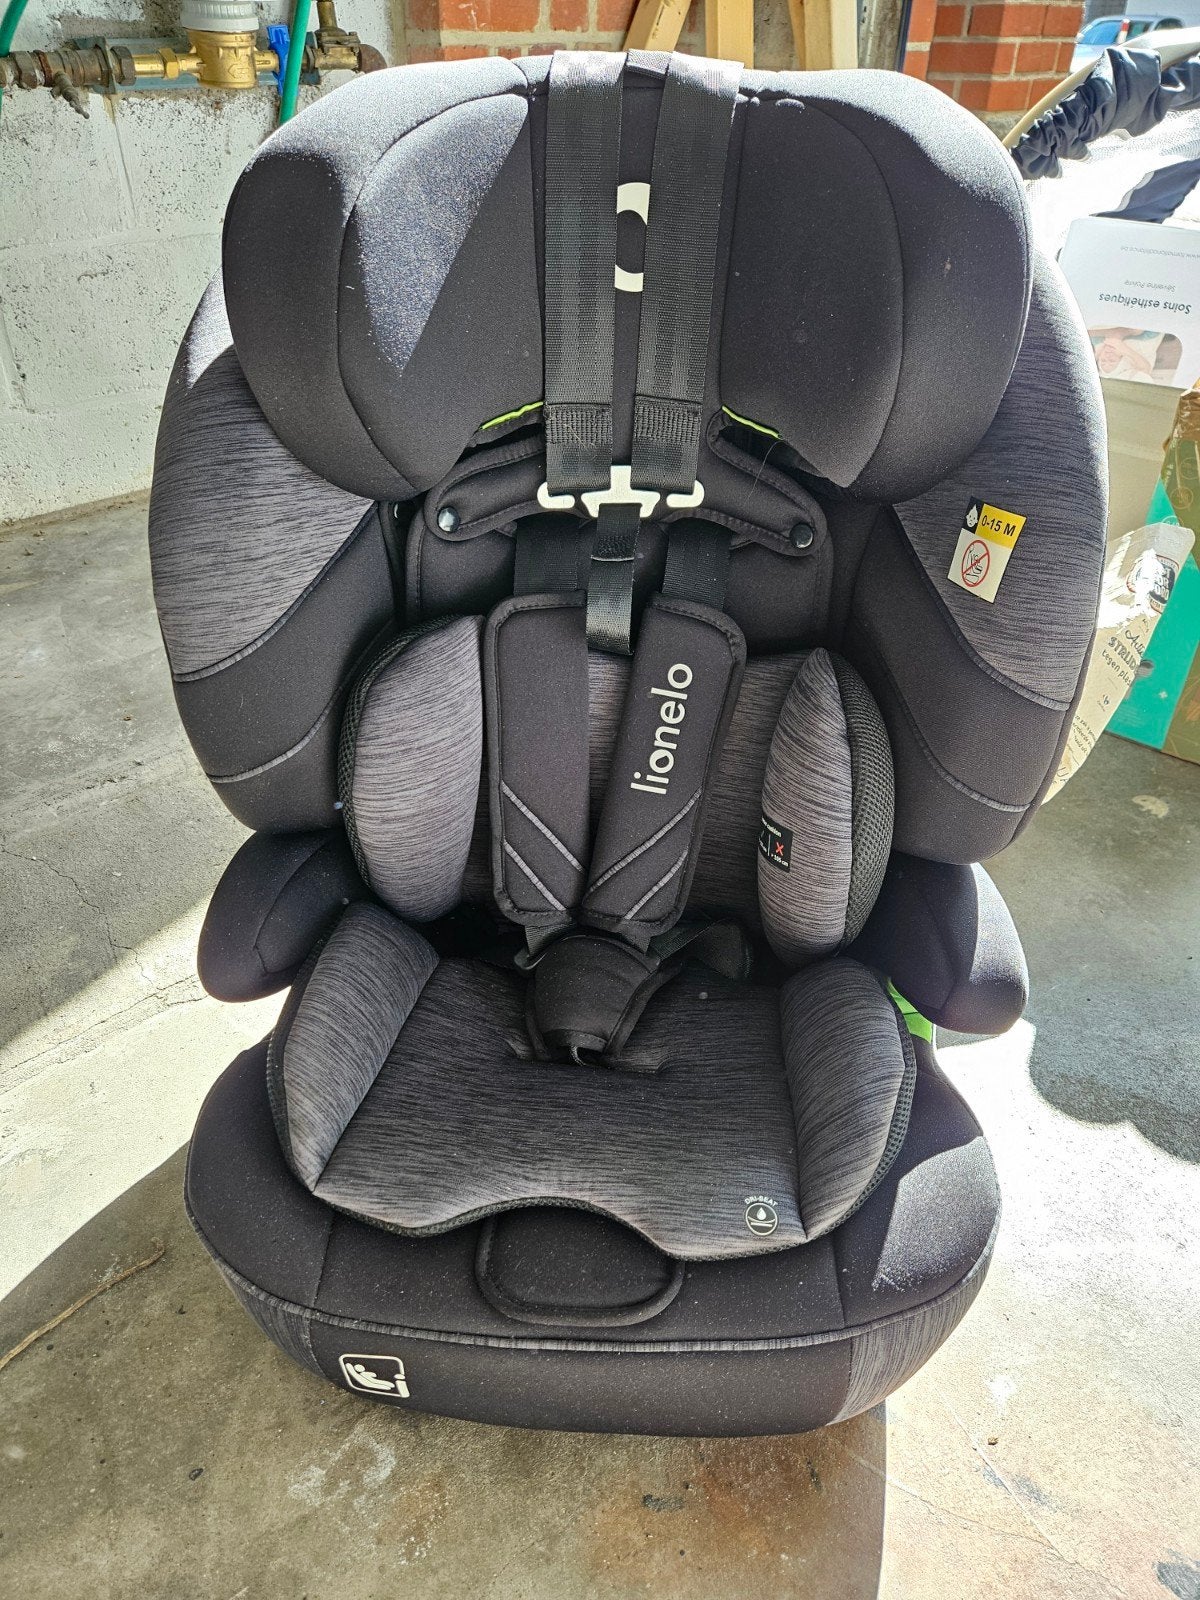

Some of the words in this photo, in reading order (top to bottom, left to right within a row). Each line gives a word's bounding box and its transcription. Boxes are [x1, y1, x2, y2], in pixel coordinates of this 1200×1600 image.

[1099, 292, 1160, 309] esthétiques
[1163, 300, 1192, 315] Soins
[981, 514, 1003, 532] 0-15
[1003, 523, 1017, 537] M
[1101, 648, 1121, 673] tegen
[631, 663, 693, 795] lionelo
